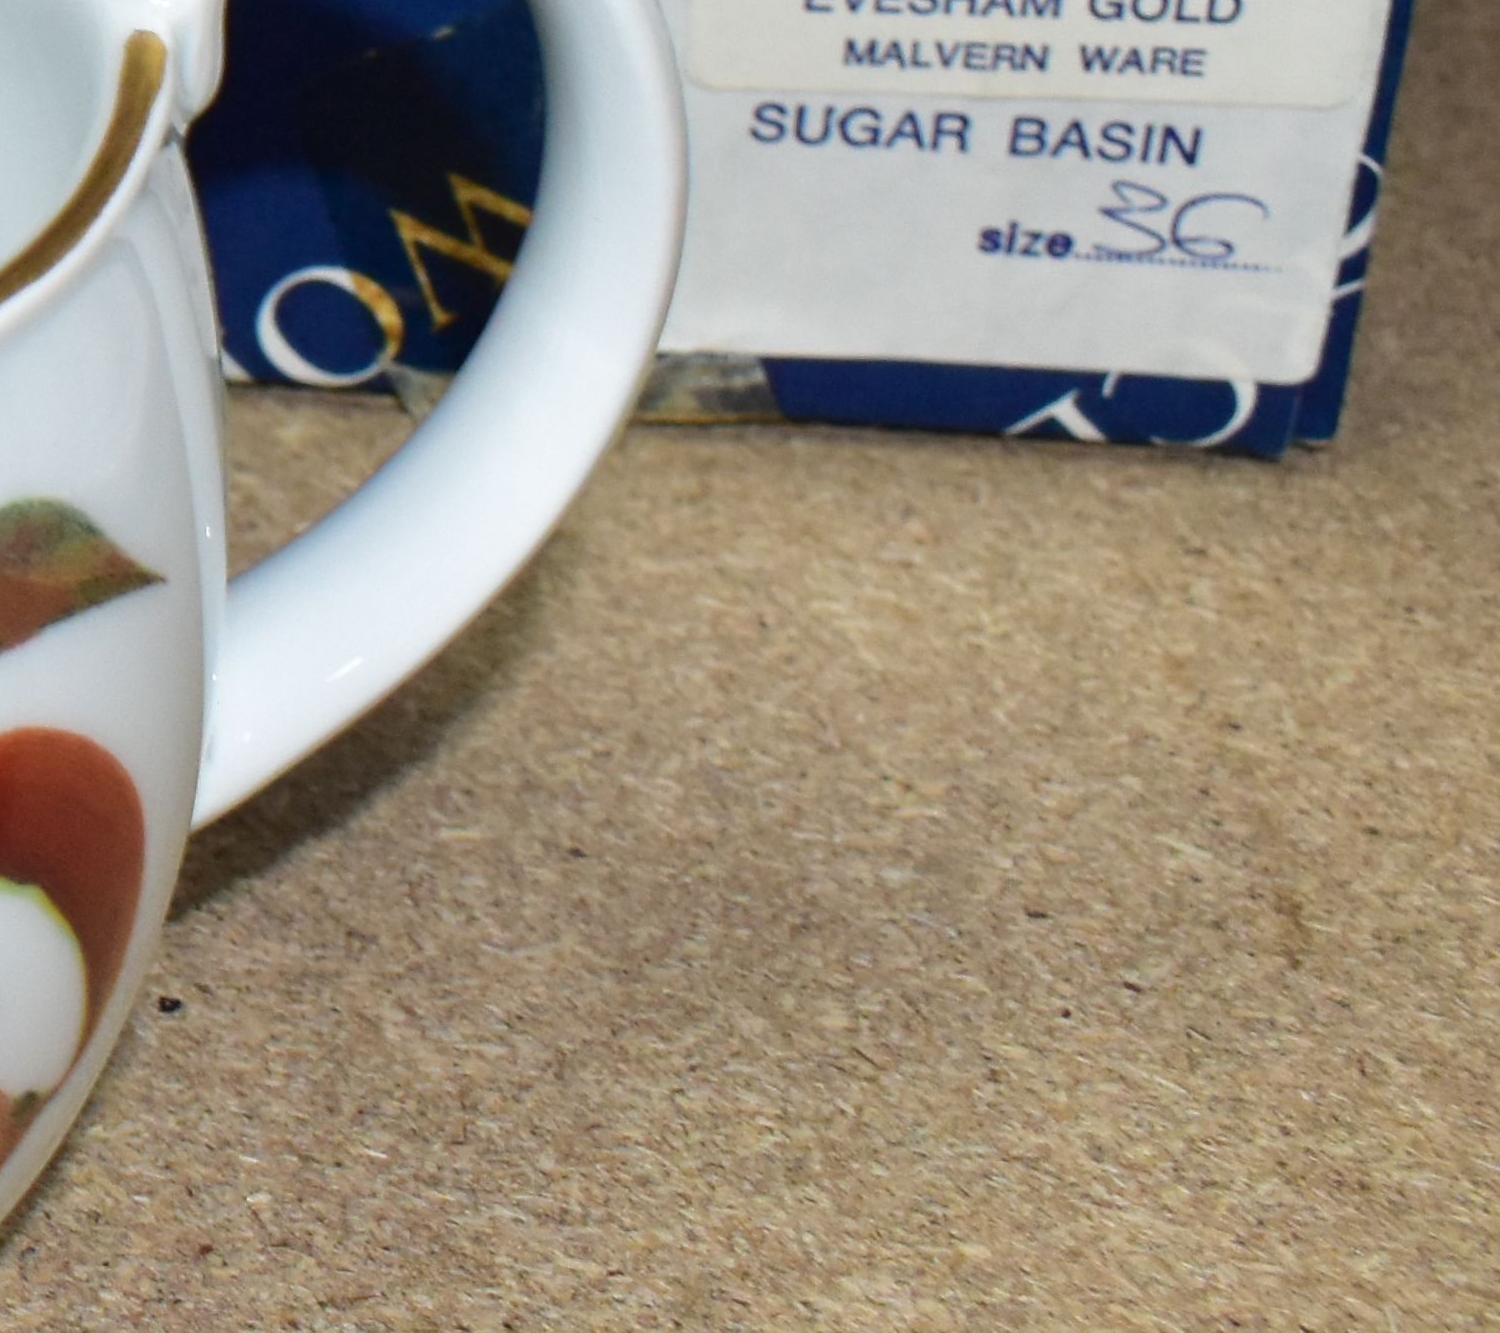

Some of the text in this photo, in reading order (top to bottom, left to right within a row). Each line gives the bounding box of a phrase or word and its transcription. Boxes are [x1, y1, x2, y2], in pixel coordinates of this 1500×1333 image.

[843, 38, 1207, 78] MALVERN WARE
[748, 101, 1204, 168] SUGAR BASIN
